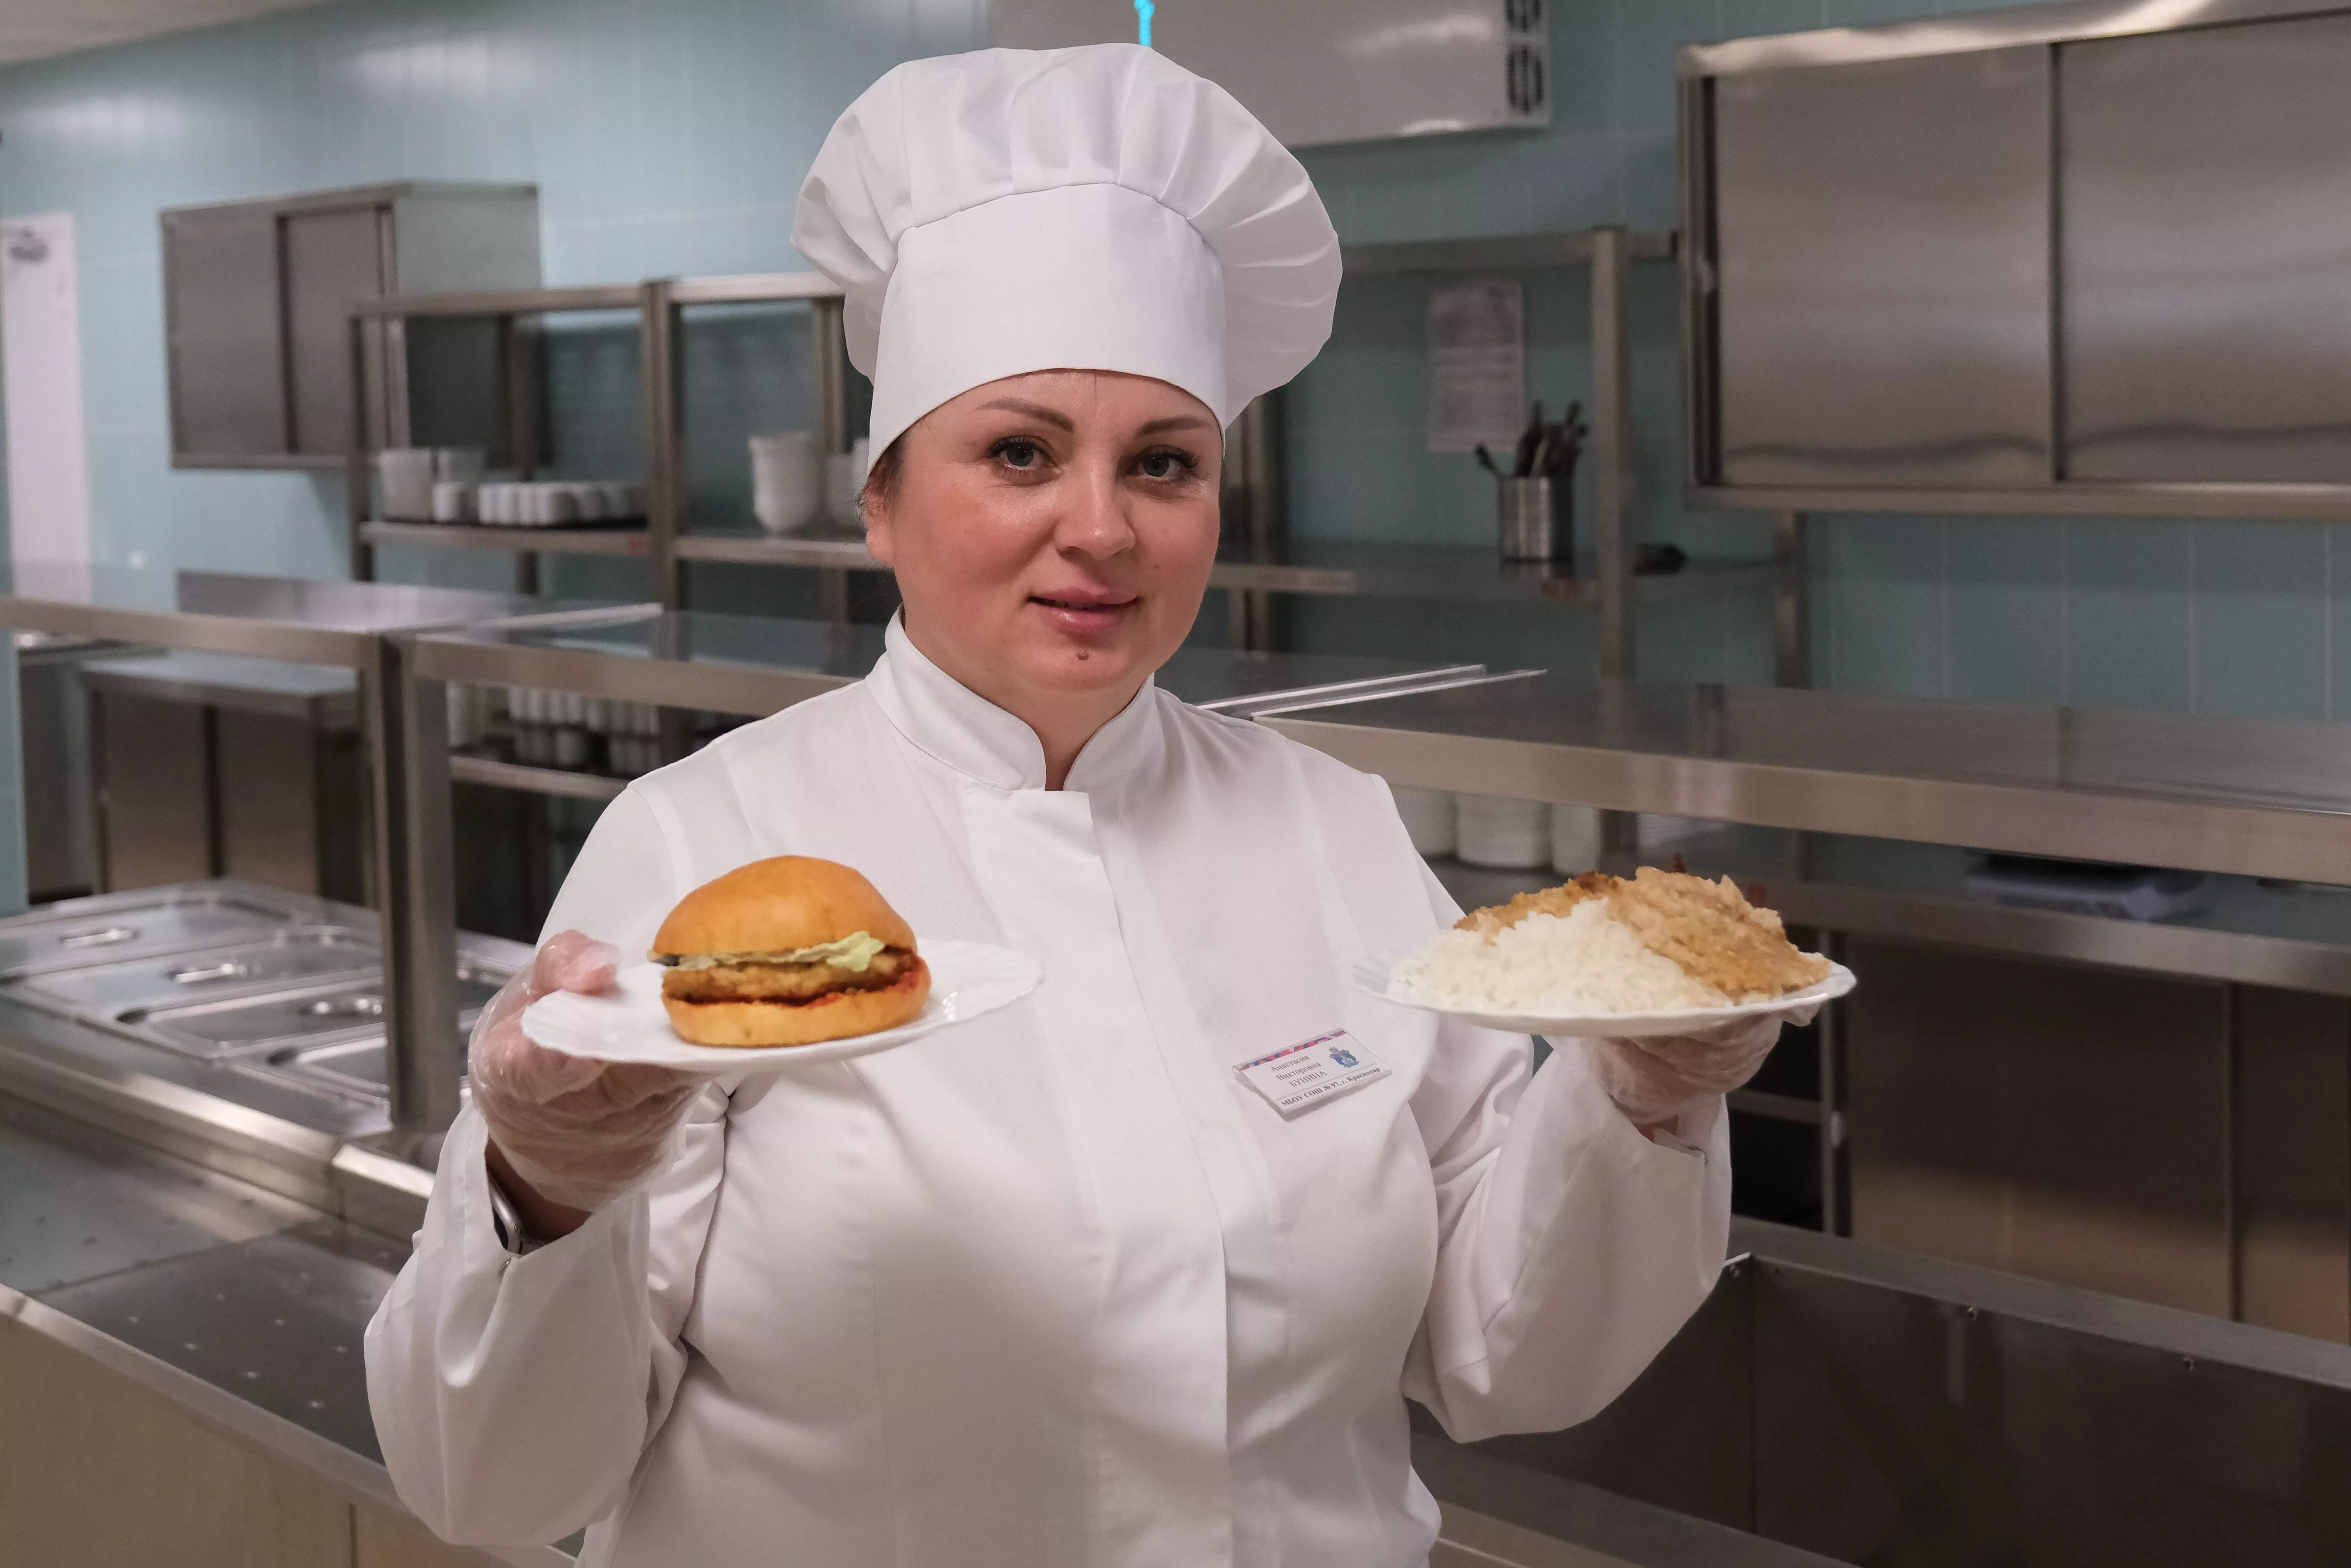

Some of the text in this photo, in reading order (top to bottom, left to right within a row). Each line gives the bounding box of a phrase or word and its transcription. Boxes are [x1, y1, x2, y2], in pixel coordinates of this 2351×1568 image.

[1271, 1055, 1309, 1072] Анастасия
[1276, 1062, 1322, 1081] Викторовна
[1281, 1095, 1303, 1107] МБОУ
[1304, 1086, 1323, 1098] СОШ
[1348, 1067, 1381, 1083] Краснодар
[1289, 1071, 1327, 1087] БУНИНА
